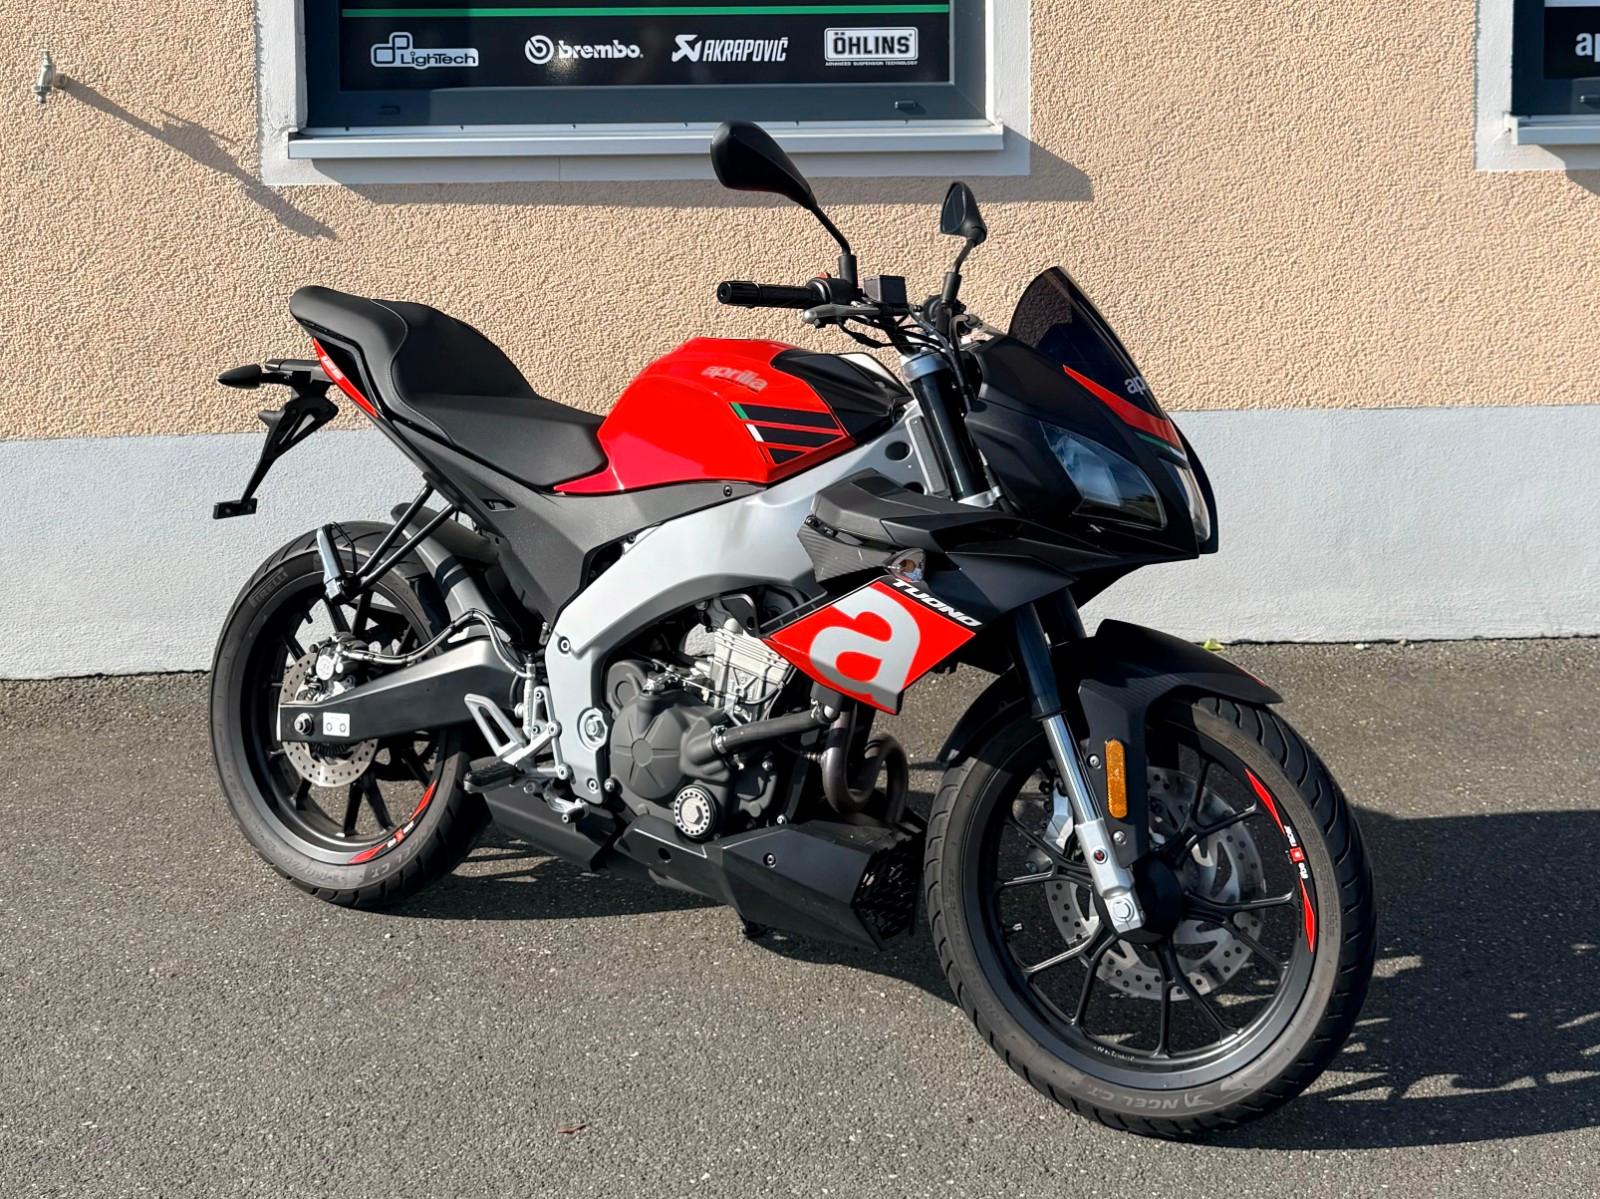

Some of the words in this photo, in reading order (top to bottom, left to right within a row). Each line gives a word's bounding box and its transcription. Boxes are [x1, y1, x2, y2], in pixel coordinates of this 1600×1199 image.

[833, 31, 911, 55] ÖHLINS
[400, 51, 476, 66] LighTech
[701, 365, 769, 392] aprilia
[892, 577, 983, 628] TUONO
